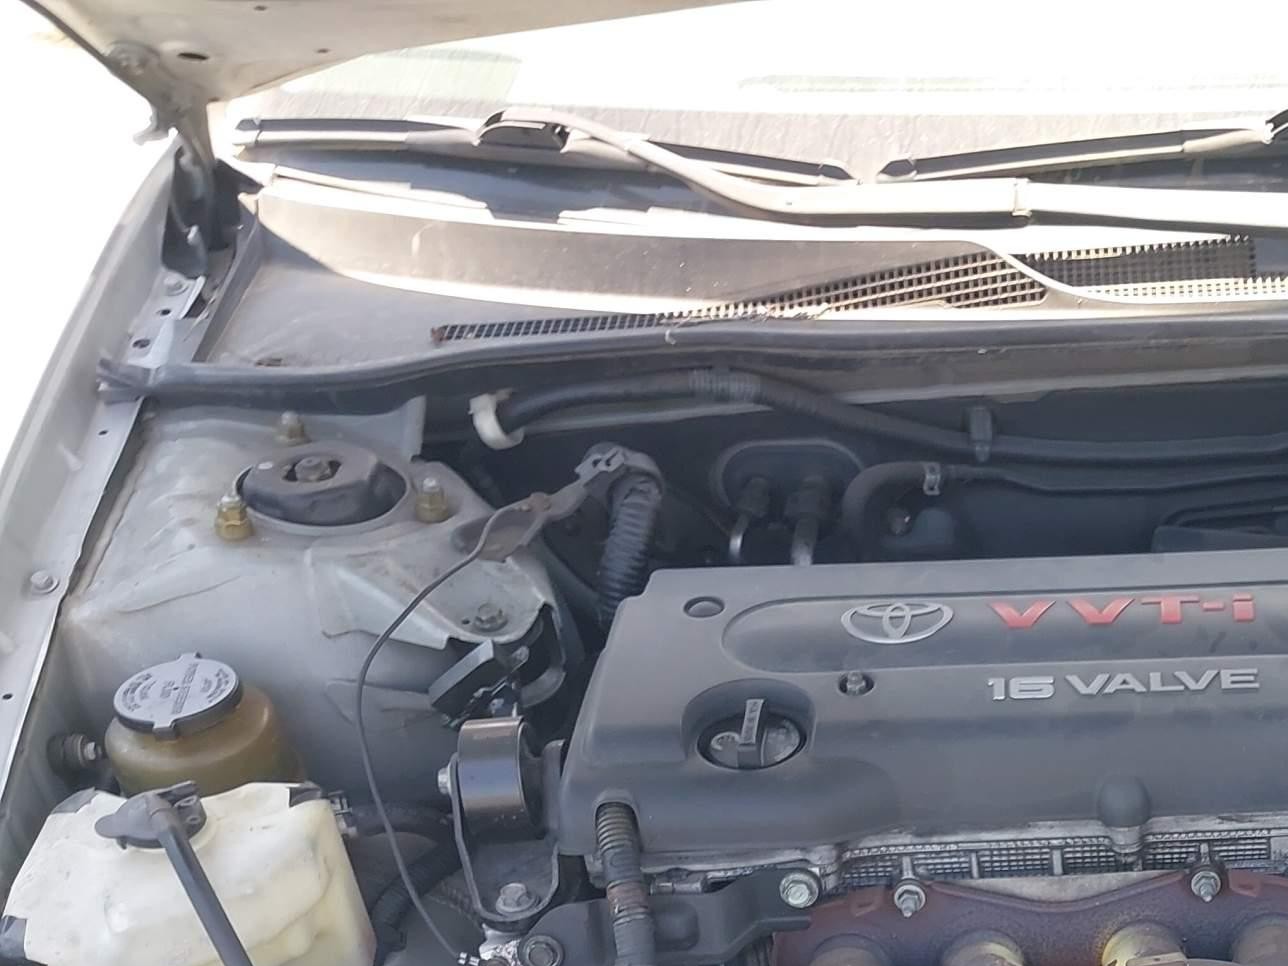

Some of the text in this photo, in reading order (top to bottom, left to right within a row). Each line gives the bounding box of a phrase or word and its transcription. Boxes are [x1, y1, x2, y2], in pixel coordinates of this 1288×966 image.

[987, 592, 1256, 628] VVT-i
[987, 668, 1261, 701] 16 VALVE
